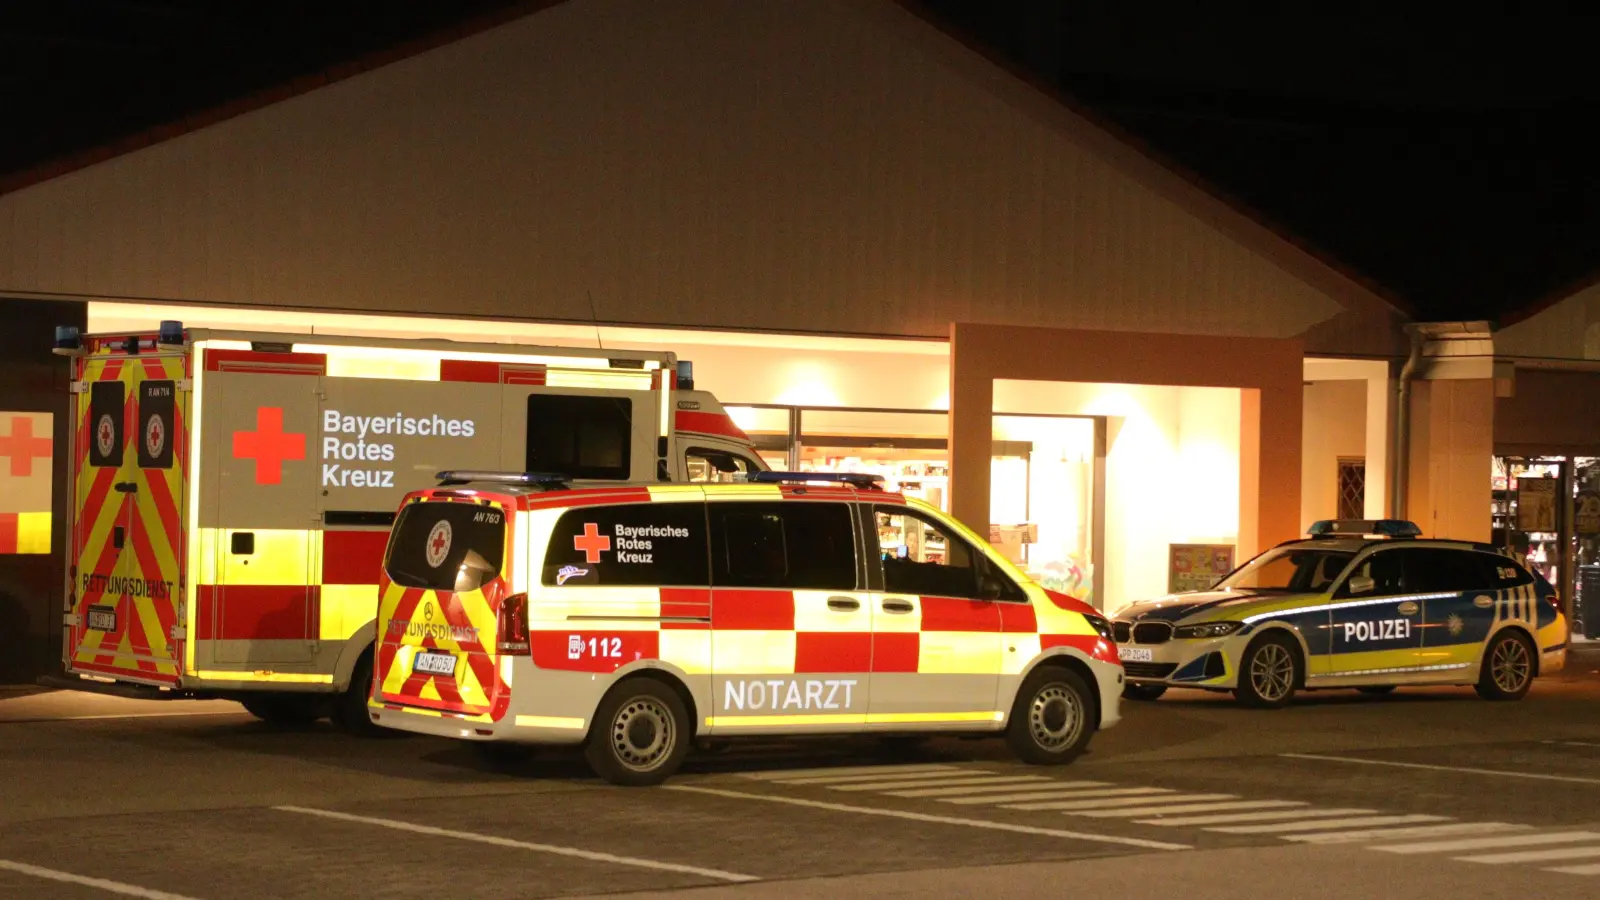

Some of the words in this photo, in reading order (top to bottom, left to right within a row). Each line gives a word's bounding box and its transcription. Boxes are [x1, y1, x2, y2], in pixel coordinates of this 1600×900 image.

[323, 409, 475, 439] Bayerisches
[323, 437, 395, 461] Rotes
[322, 463, 395, 488] Kreuz
[473, 511, 485, 522] AN
[485, 513, 500, 524] 76/3
[615, 524, 689, 539] Bayerisches
[616, 537, 652, 550] Rotes
[617, 551, 653, 563] Kreuz
[82, 573, 173, 599] RETTUNGSDIENST
[387, 619, 480, 644] RETTUNGSDIENST
[1344, 618, 1410, 642] POLIZEI
[588, 636, 622, 657] 112
[724, 680, 857, 710] NOTARZT
